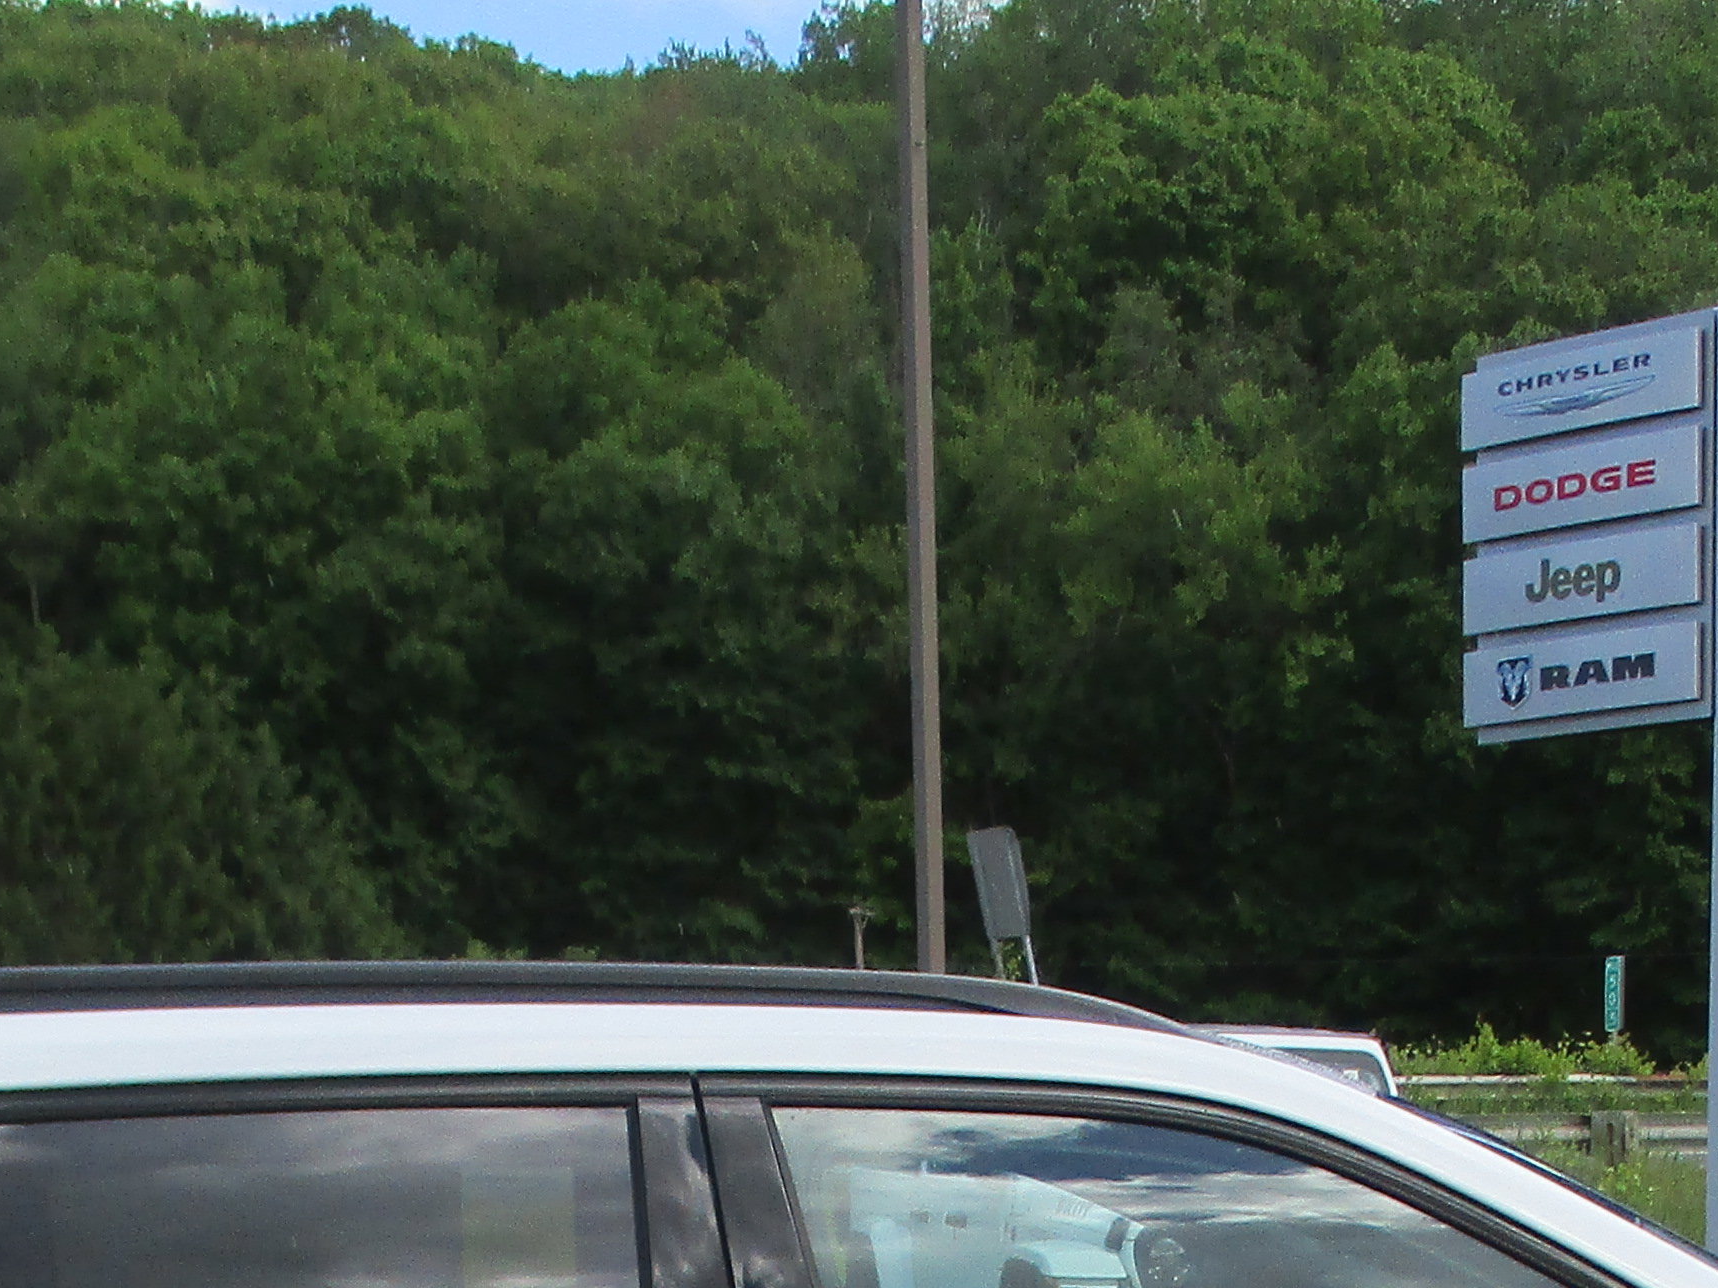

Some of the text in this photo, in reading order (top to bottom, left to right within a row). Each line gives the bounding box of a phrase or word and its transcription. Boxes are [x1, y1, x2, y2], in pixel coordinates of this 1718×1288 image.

[1498, 354, 1651, 396] CHRYSLER
[1494, 459, 1656, 511] DODGE
[1525, 558, 1621, 602] Jeep
[1540, 652, 1655, 692] RAM
